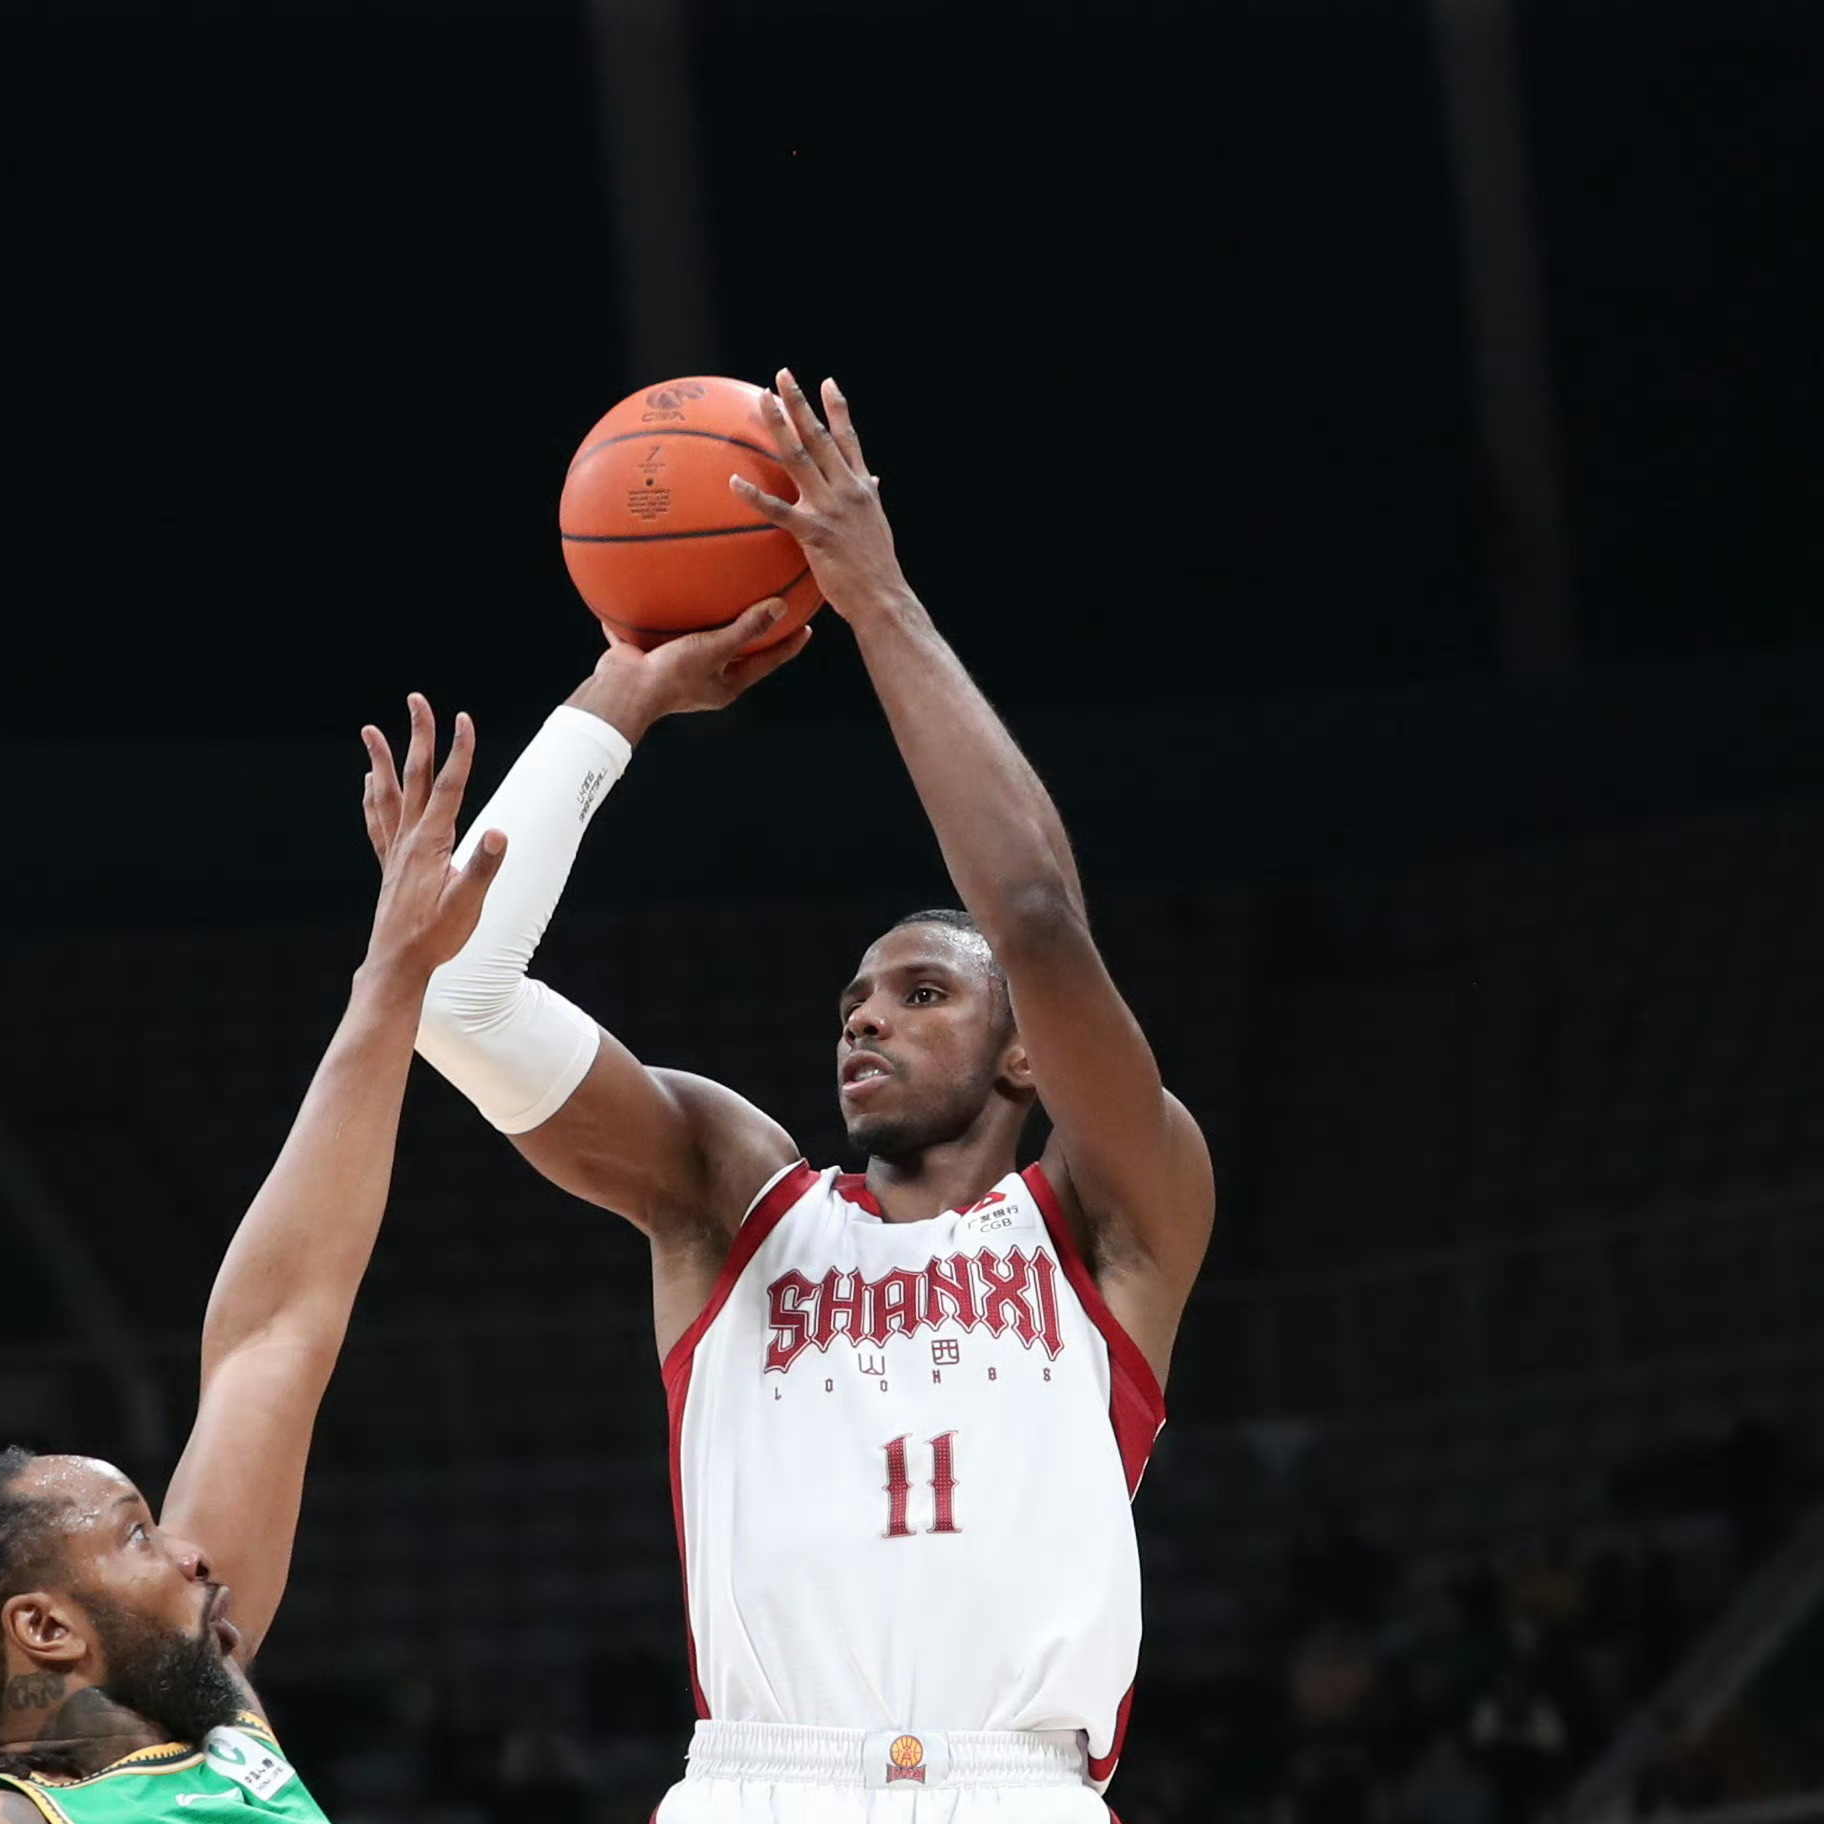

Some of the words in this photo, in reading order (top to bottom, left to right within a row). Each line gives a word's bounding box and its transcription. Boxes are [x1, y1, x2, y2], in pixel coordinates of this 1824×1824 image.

[980, 1217, 1013, 1233] CGB
[763, 1244, 1064, 1374] SHANXI
[879, 1429, 963, 1539] 11
